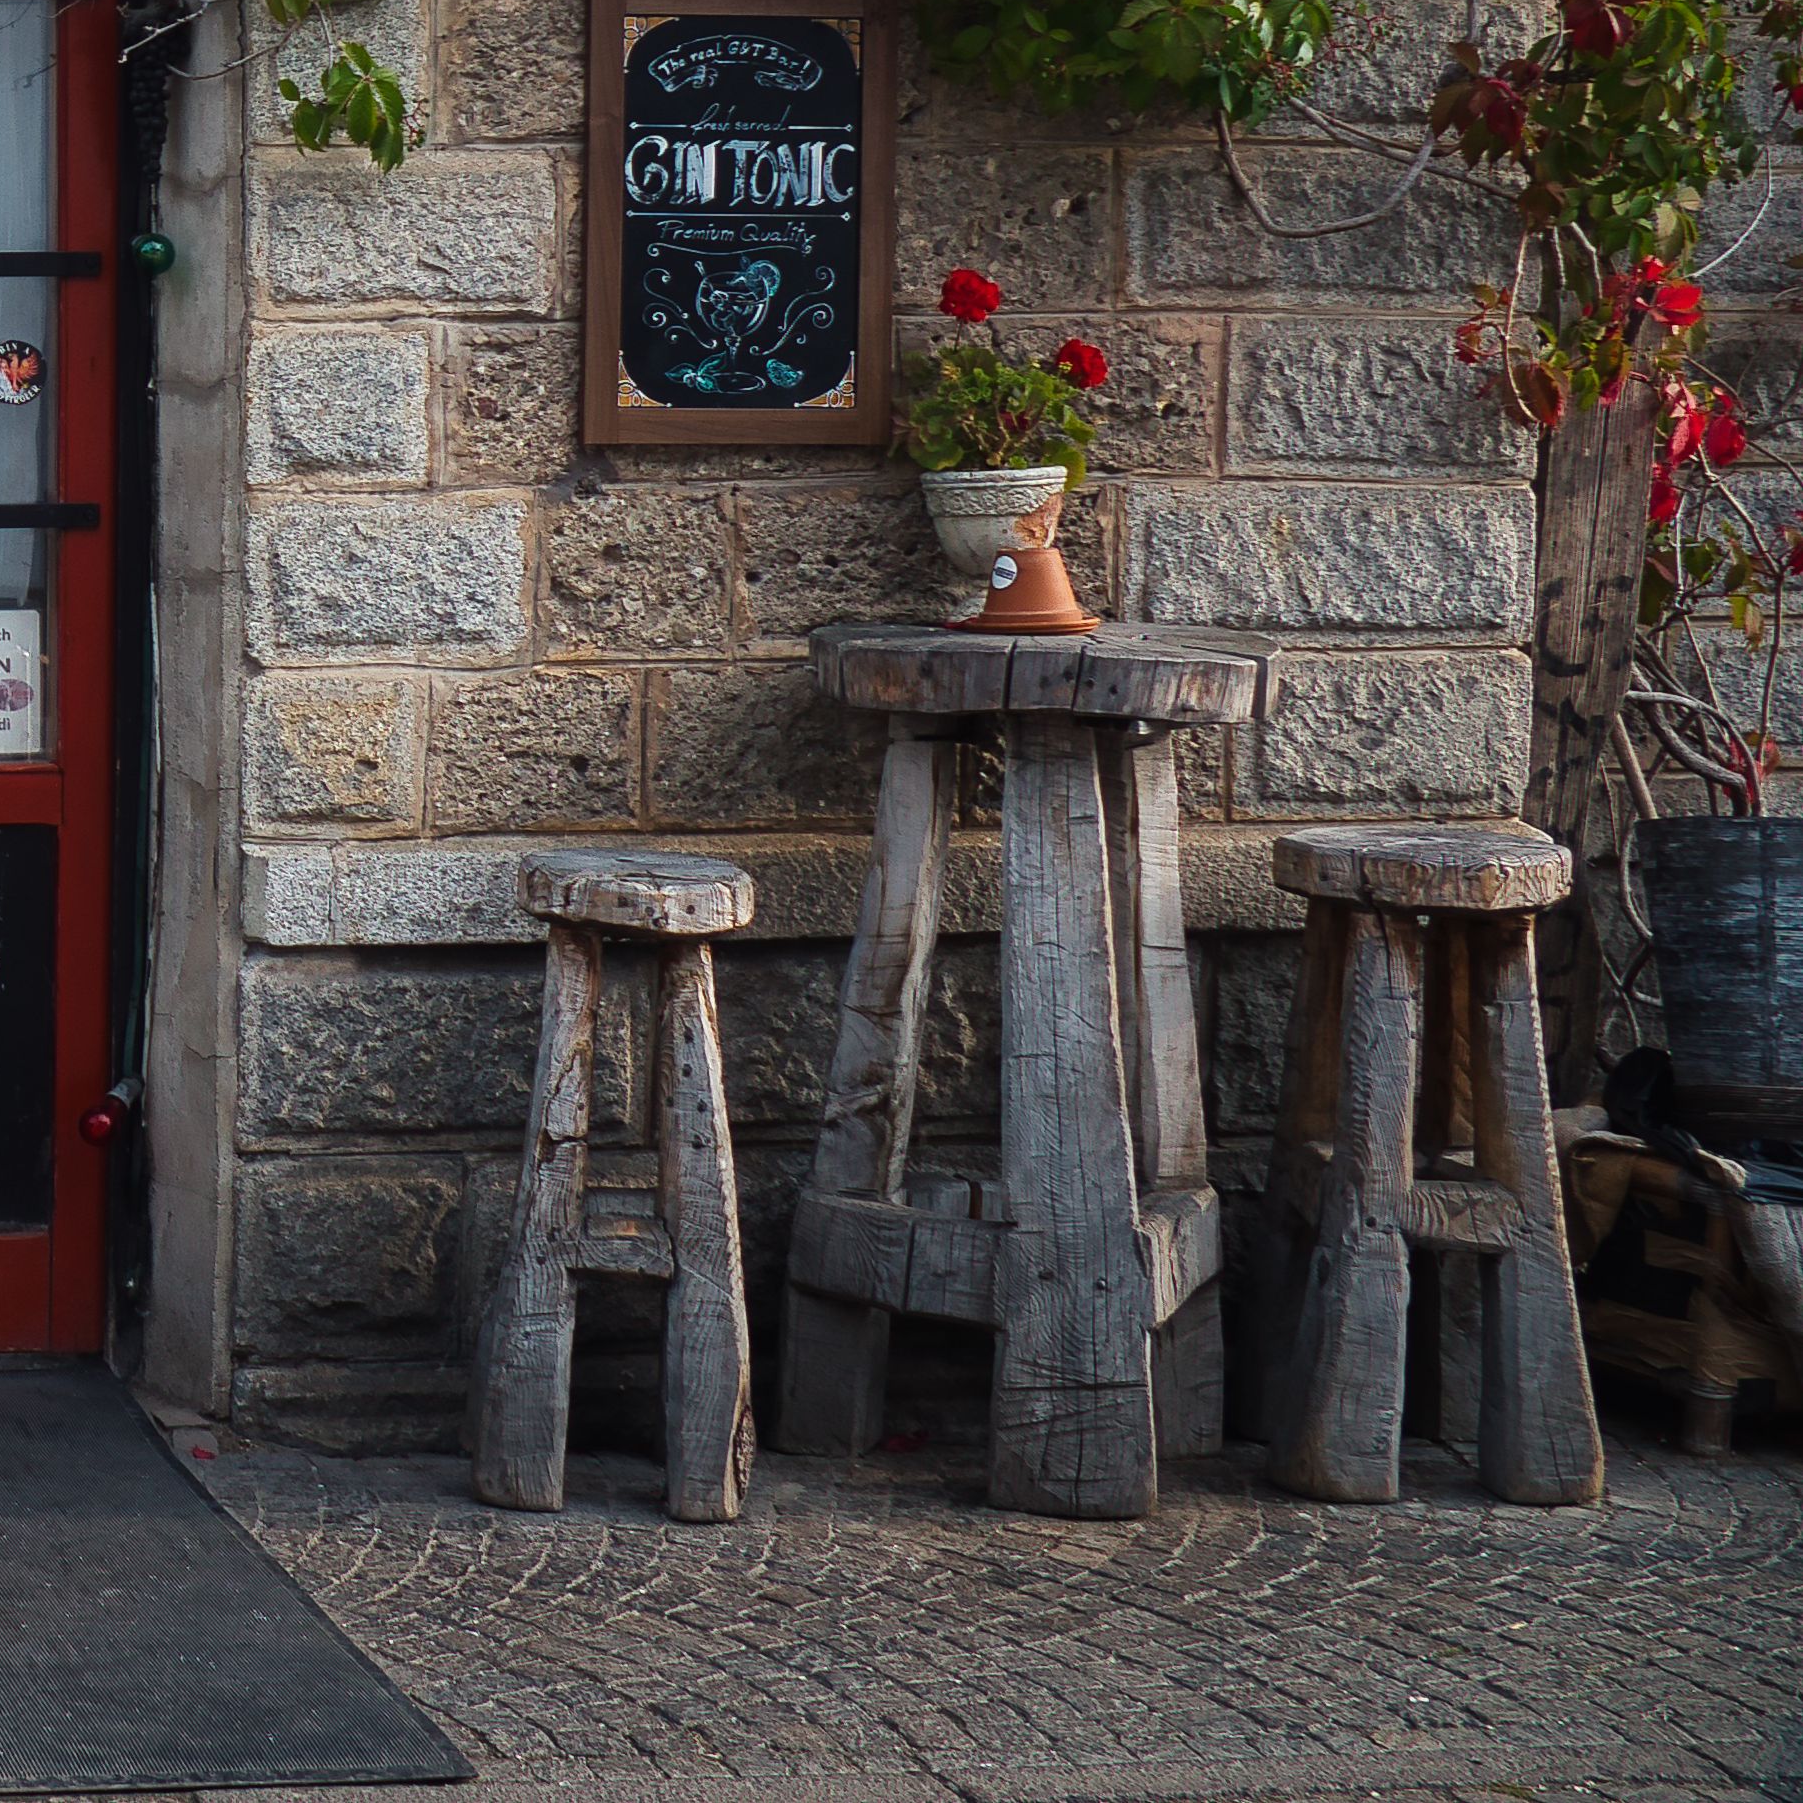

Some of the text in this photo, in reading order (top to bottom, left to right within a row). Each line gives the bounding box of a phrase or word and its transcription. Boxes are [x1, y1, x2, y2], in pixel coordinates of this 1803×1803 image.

[657, 58, 686, 76] The
[690, 42, 723, 62] real
[727, 41, 765, 57] G&T
[624, 134, 856, 209] GIN TONIC
[657, 219, 817, 244] Premium Quality
